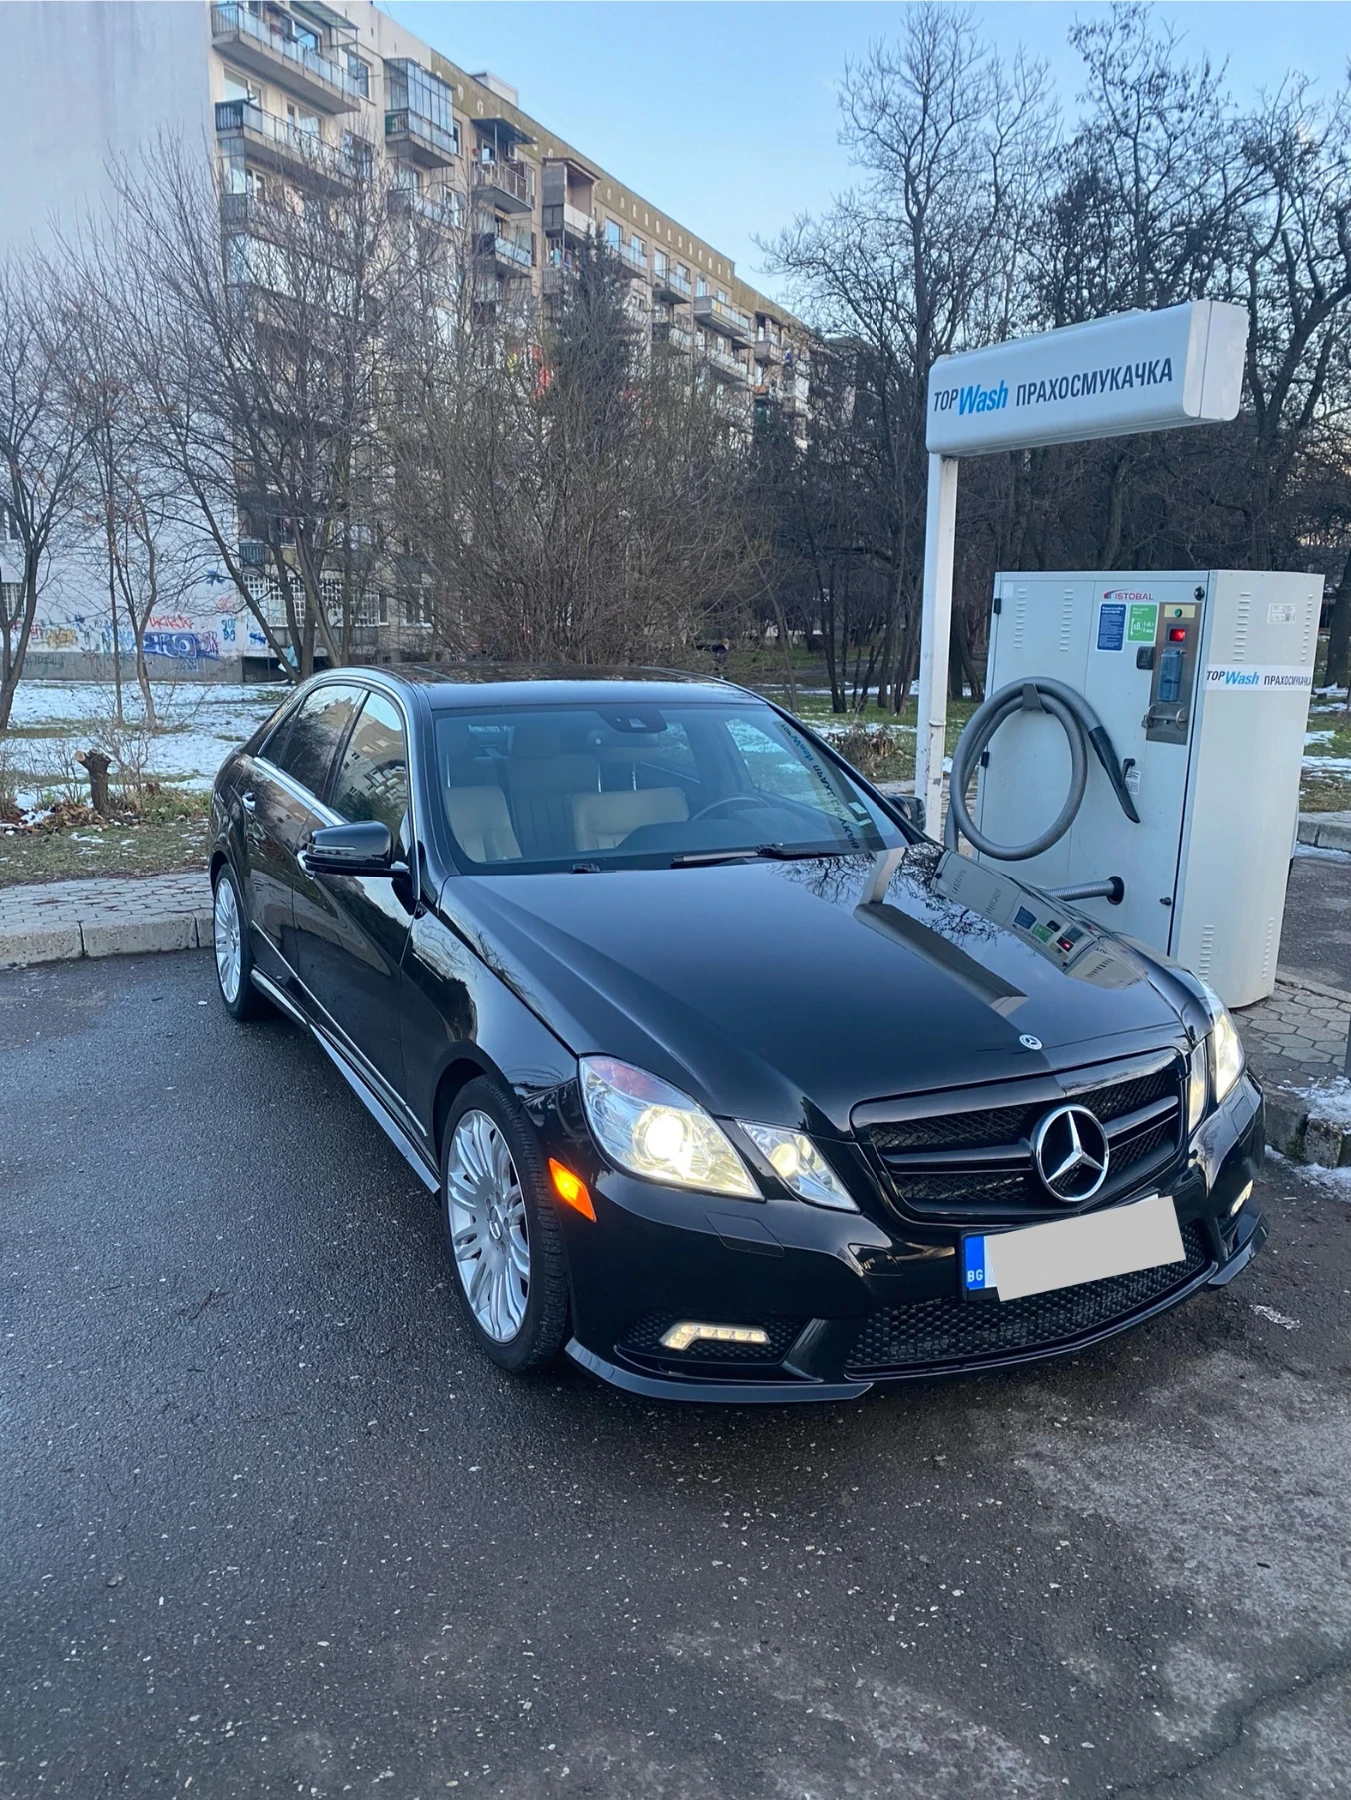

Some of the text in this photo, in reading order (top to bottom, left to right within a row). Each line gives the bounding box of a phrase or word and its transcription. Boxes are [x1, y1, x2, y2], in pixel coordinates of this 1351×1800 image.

[934, 357, 1173, 416] TOPWash ПРАХОСМУКАЧКА
[1114, 592, 1153, 600] ISTOBAL
[1206, 671, 1311, 687] TOPWash ПРАХОСМУКАЧКА
[967, 1269, 983, 1283] BG
